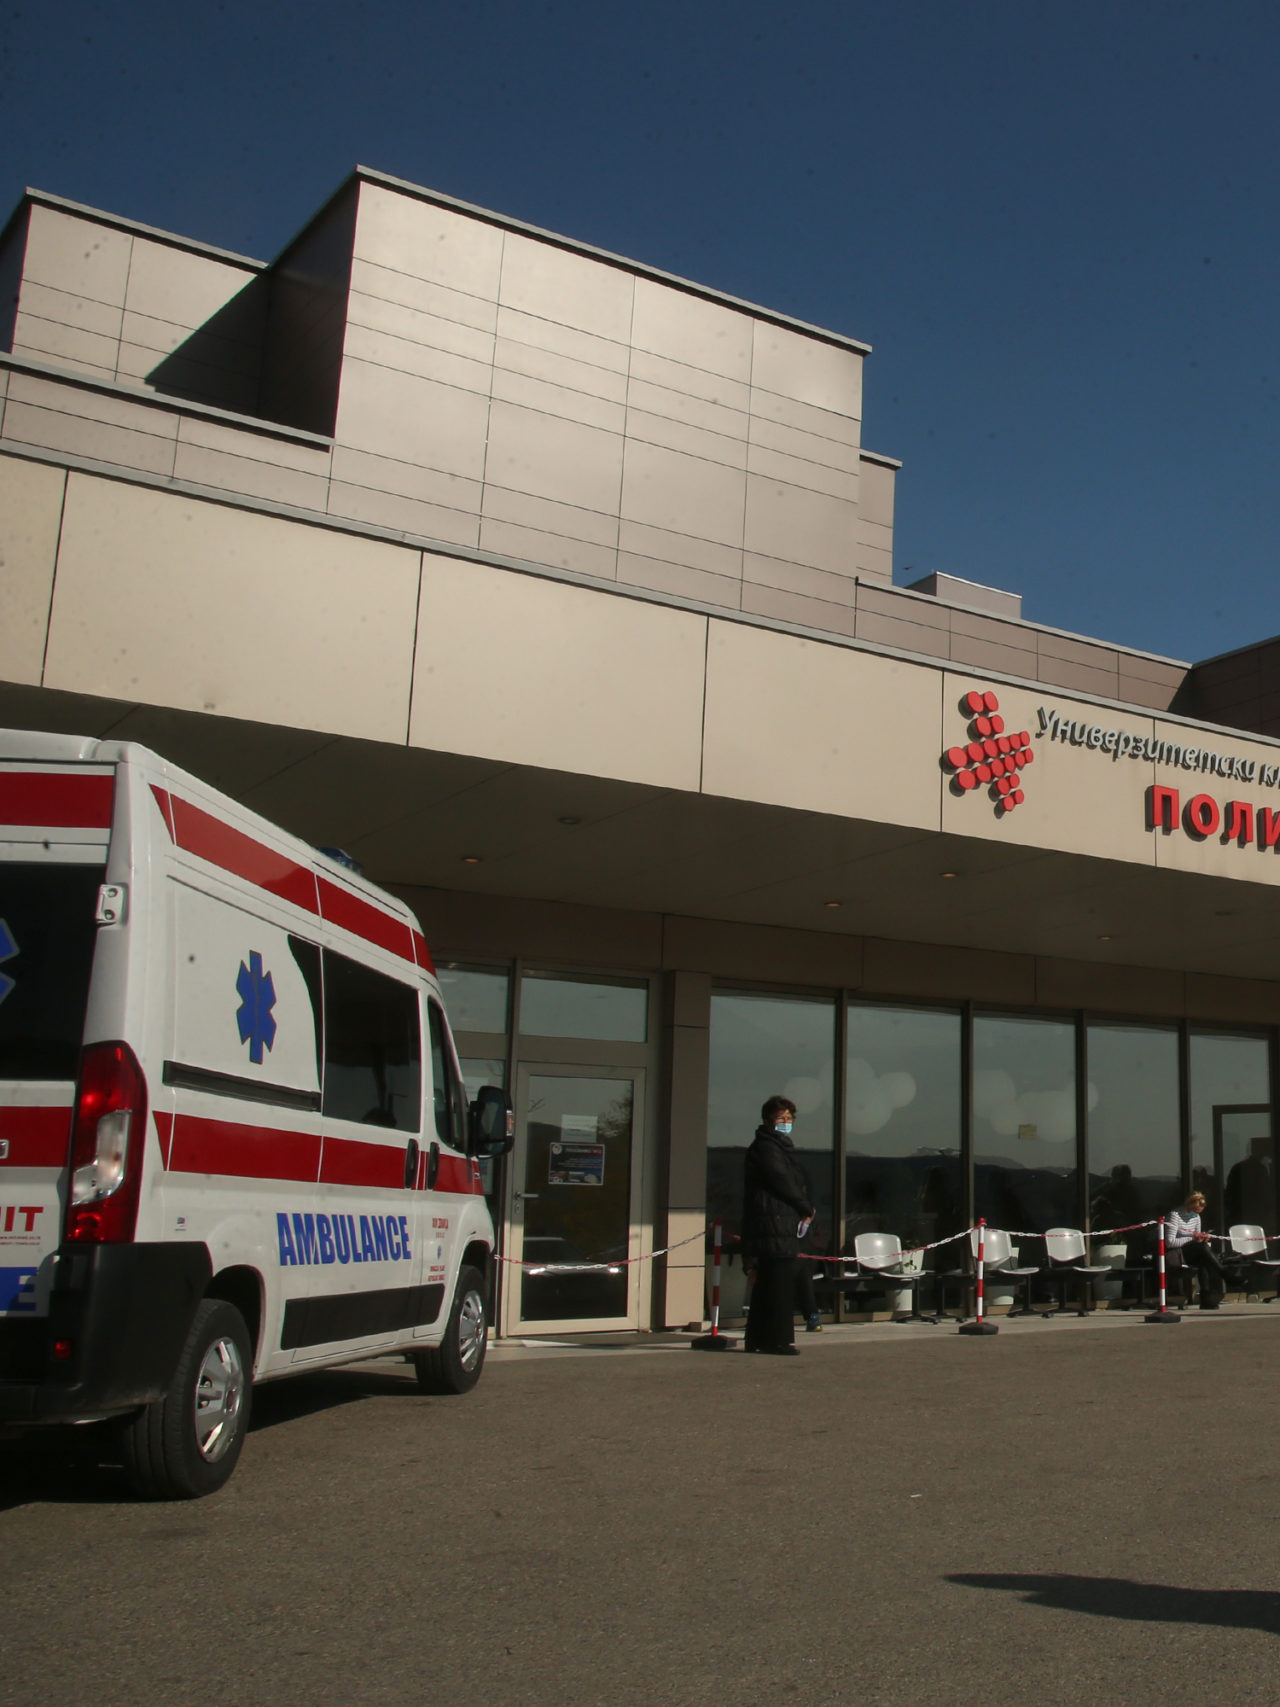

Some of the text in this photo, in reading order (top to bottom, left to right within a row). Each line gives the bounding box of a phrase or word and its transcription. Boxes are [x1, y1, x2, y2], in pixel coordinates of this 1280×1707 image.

[1037, 706, 1258, 781] Универзитетски
[0, 1206, 44, 1232] IT
[276, 1212, 412, 1267] AMBULANCE
